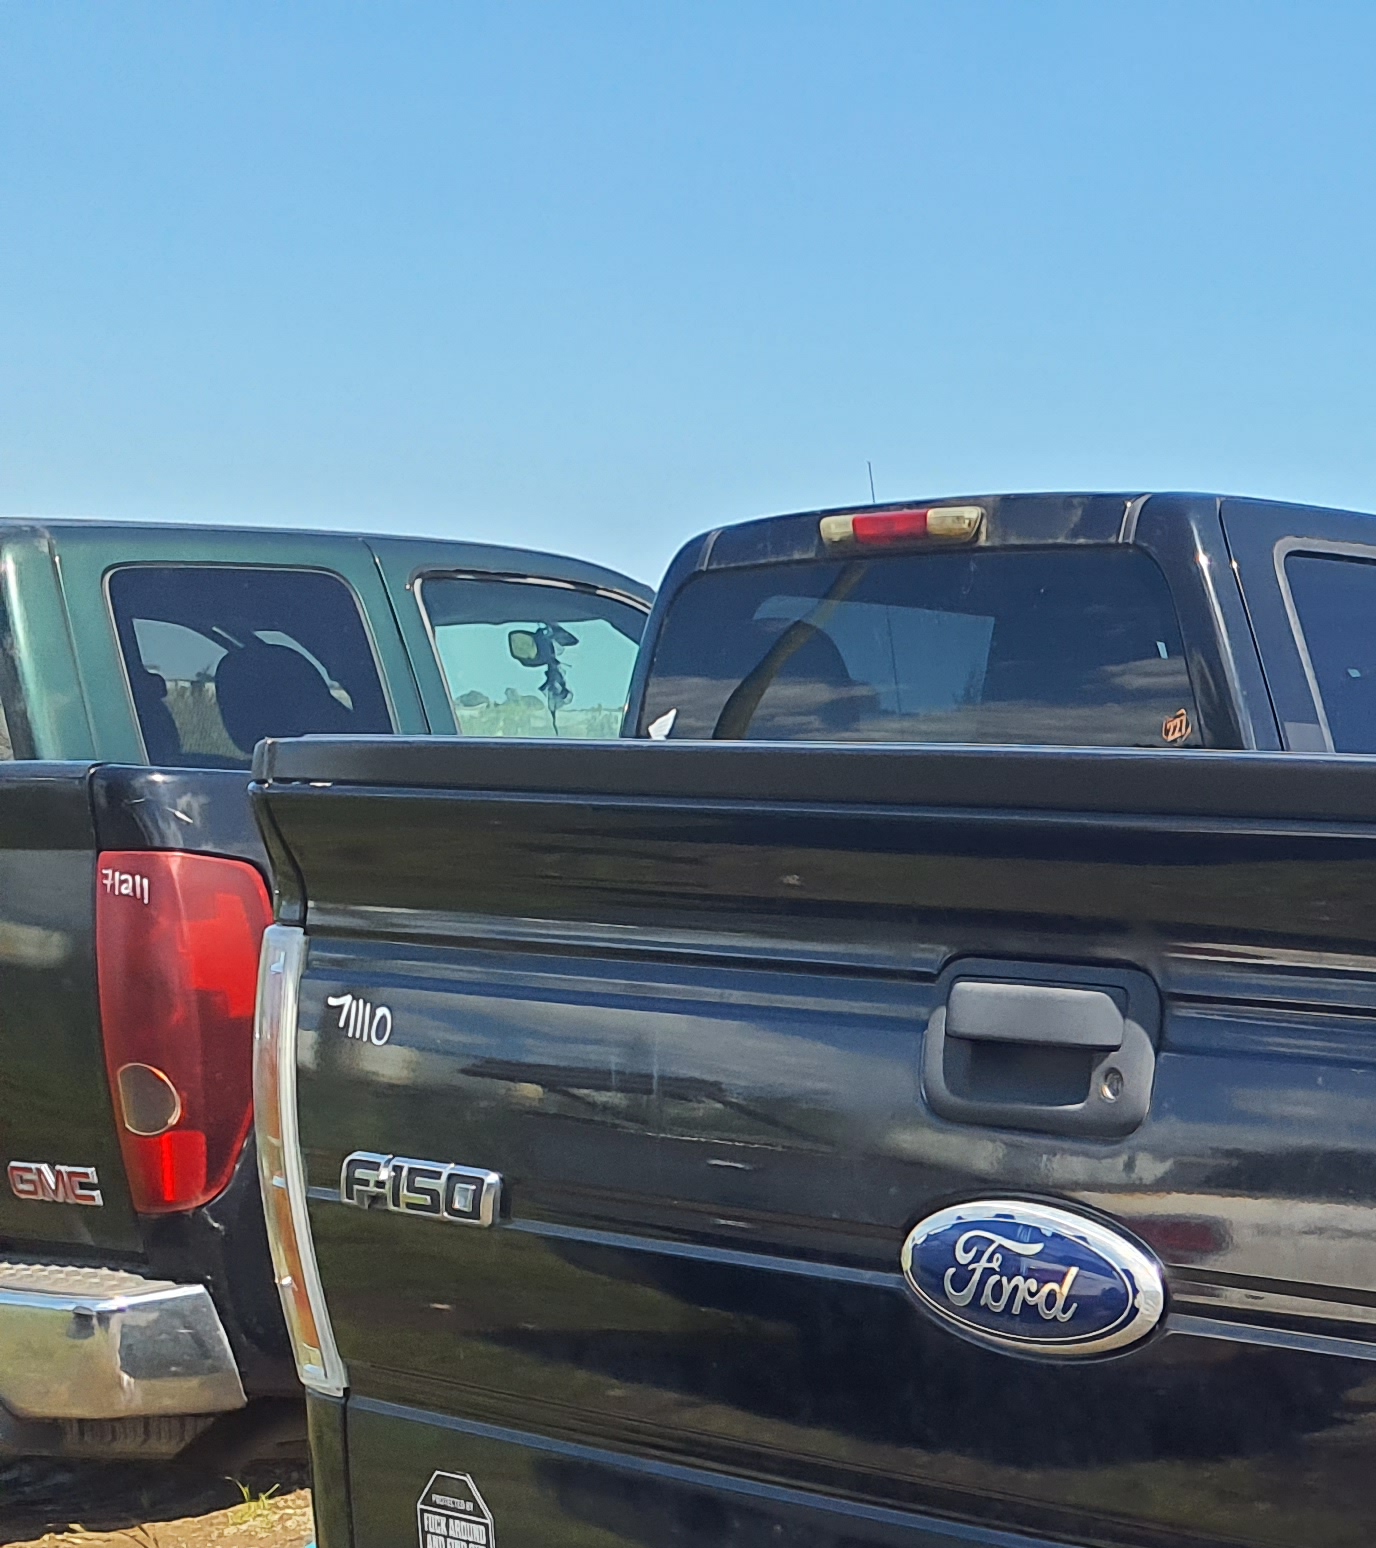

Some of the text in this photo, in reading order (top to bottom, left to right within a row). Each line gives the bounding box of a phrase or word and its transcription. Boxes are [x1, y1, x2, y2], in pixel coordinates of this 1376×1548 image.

[7, 1160, 103, 1206] GMC
[340, 1150, 502, 1228] F-150
[943, 1229, 1080, 1322] Ford
[423, 1512, 448, 1536] FUCK
